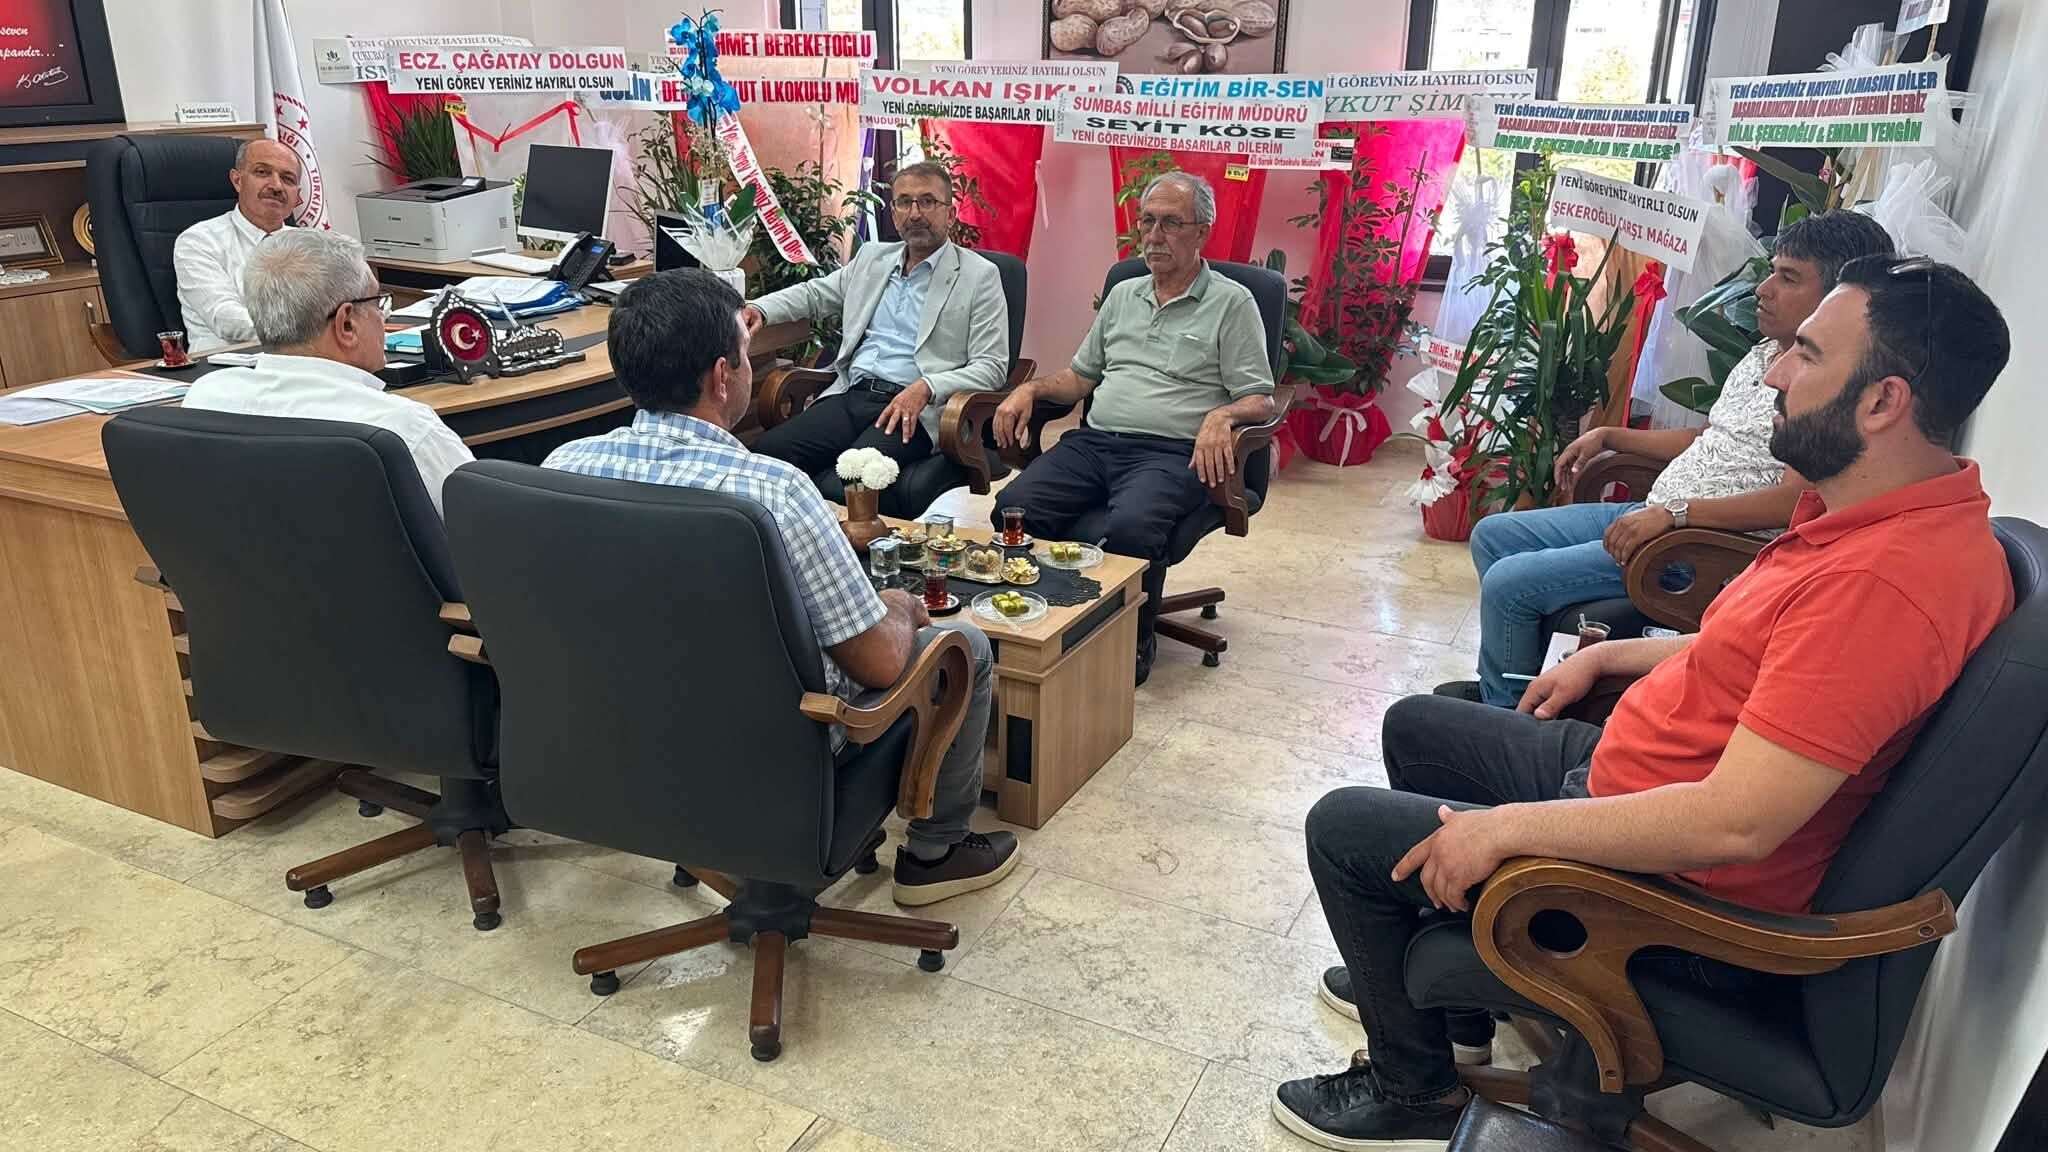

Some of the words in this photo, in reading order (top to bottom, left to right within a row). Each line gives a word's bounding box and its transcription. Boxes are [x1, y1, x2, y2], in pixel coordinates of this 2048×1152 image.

[399, 53, 447, 70] ECZ.
[452, 49, 542, 73] ÇAĞATAY
[549, 53, 625, 69] DOLGUN
[958, 64, 989, 75] GÖREV
[990, 64, 1029, 76] YERİNİZ
[1032, 66, 1070, 76] HAYIRLI
[1072, 66, 1106, 77] OLSUN
[416, 74, 444, 90] YENİ
[447, 75, 485, 90] GÖREV
[488, 73, 533, 89] YERİNİZ
[536, 76, 576, 89] HAYIRLI
[579, 76, 614, 88] OLSUN
[762, 76, 832, 103] İLKOKULU
[872, 75, 992, 98] VOLKAN
[1140, 77, 1220, 97] EĞİTİM
[1227, 77, 1323, 98] BİR-SEN
[1338, 73, 1418, 89] GÖREVİNİZ
[1422, 73, 1481, 87] HAYIRLI
[1485, 73, 1535, 86] OLSUN
[1730, 82, 1752, 99] YENİ
[1751, 80, 1807, 99] GÖREVİNİZ
[1806, 78, 1846, 97] HAYIRLI
[1844, 74, 1896, 95] OLMASINI
[1896, 70, 1938, 91] DİLER
[883, 99, 905, 115] YENİ
[976, 105, 1031, 122] BAŞARILAR
[1073, 96, 1132, 115] SUMBAS
[1136, 99, 1176, 118] MİLLİ
[1181, 101, 1234, 121] EĞİTİM
[1238, 103, 1308, 123] MÜDÜRÜ
[1494, 103, 1515, 115] YENİ
[1516, 104, 1575, 119] GÖREVİNİZİN
[1576, 108, 1612, 121] HAYIRLI
[1612, 110, 1658, 122] OLMASINI
[1658, 108, 1690, 123] DİLER
[1890, 90, 1928, 114] EDERİZ
[1086, 117, 1187, 134] SEYİT
[1199, 123, 1297, 140] KÖSE
[1648, 123, 1678, 139] EDERİZ
[1728, 122, 1754, 141] HİLAL
[1754, 121, 1818, 145] ŞEKEROĞLU
[1816, 126, 1825, 142] &
[1871, 118, 1922, 142] YENGİN
[1072, 129, 1095, 142] YENİ
[1098, 131, 1168, 149] GÖREVİNİZDE
[1237, 139, 1284, 155] DİLERİM
[1314, 140, 1341, 149] Olsun
[1494, 132, 1532, 150] İRFAN
[1533, 137, 1611, 156] ŞEKEROĞLU
[1612, 142, 1631, 157] VE
[1561, 174, 1583, 189] YENİ
[1584, 178, 1628, 202] GÖREVİNİZ
[1628, 192, 1665, 213] HAYIRLI
[1667, 202, 1699, 223] OLSUN
[1553, 200, 1617, 227] ŞEKEROĞLU
[1618, 216, 1643, 240] ÇARŞI
[1647, 226, 1688, 255] MAĞAZA
